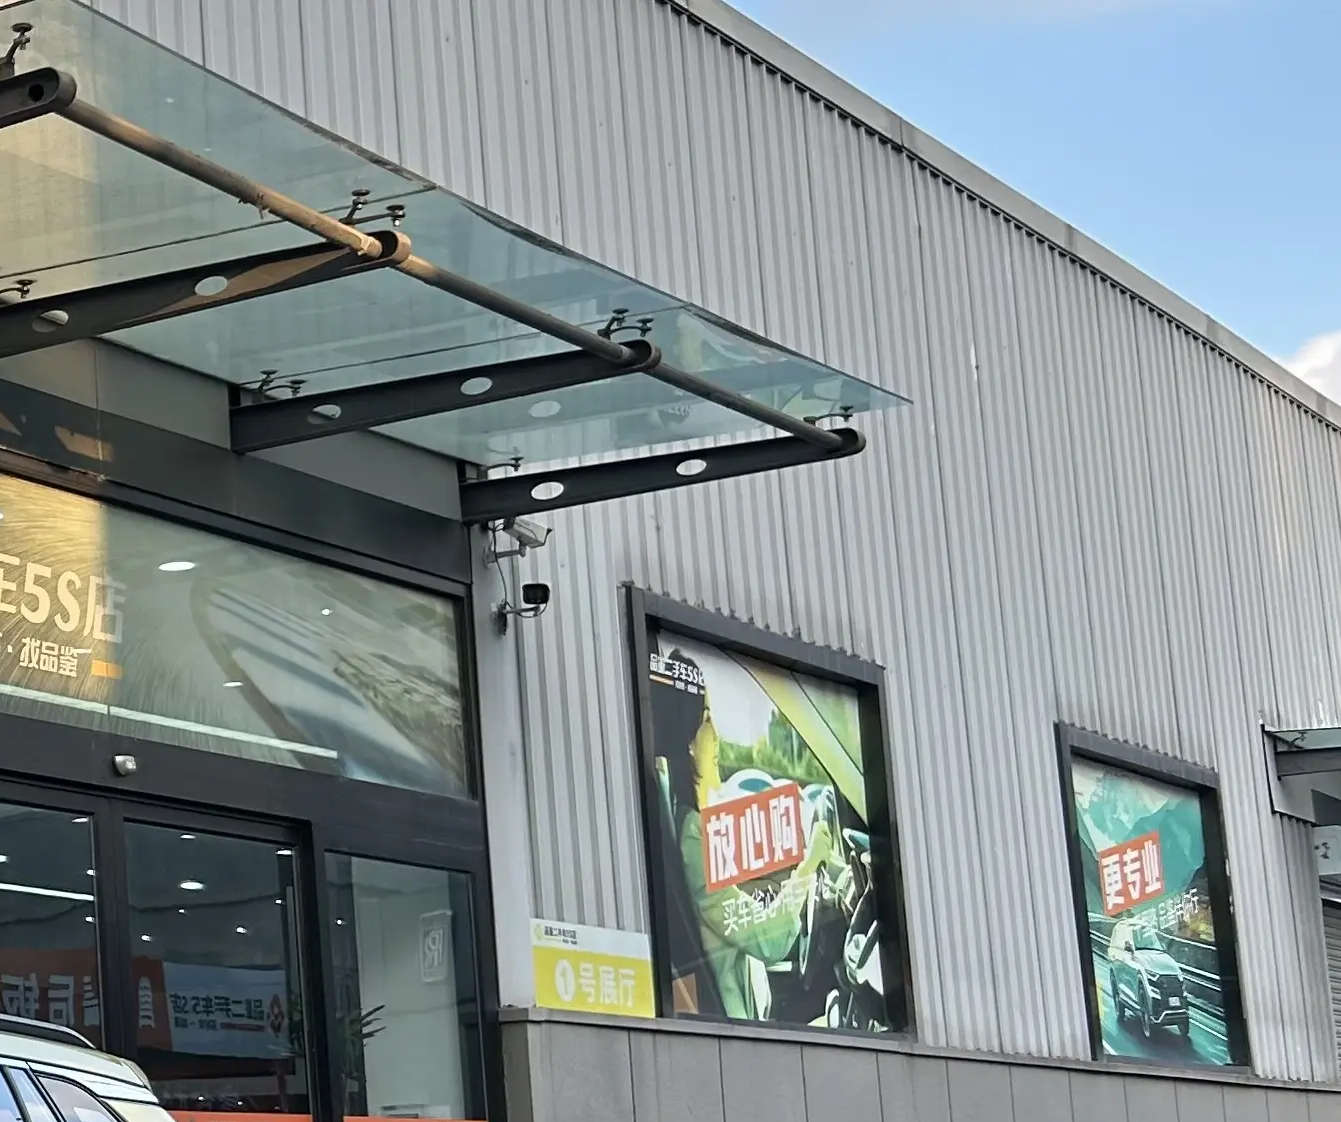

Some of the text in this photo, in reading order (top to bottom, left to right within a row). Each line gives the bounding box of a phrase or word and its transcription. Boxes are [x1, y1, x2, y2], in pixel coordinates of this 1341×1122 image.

[706, 795, 798, 884] 放心购
[1101, 839, 1162, 911] 更专业
